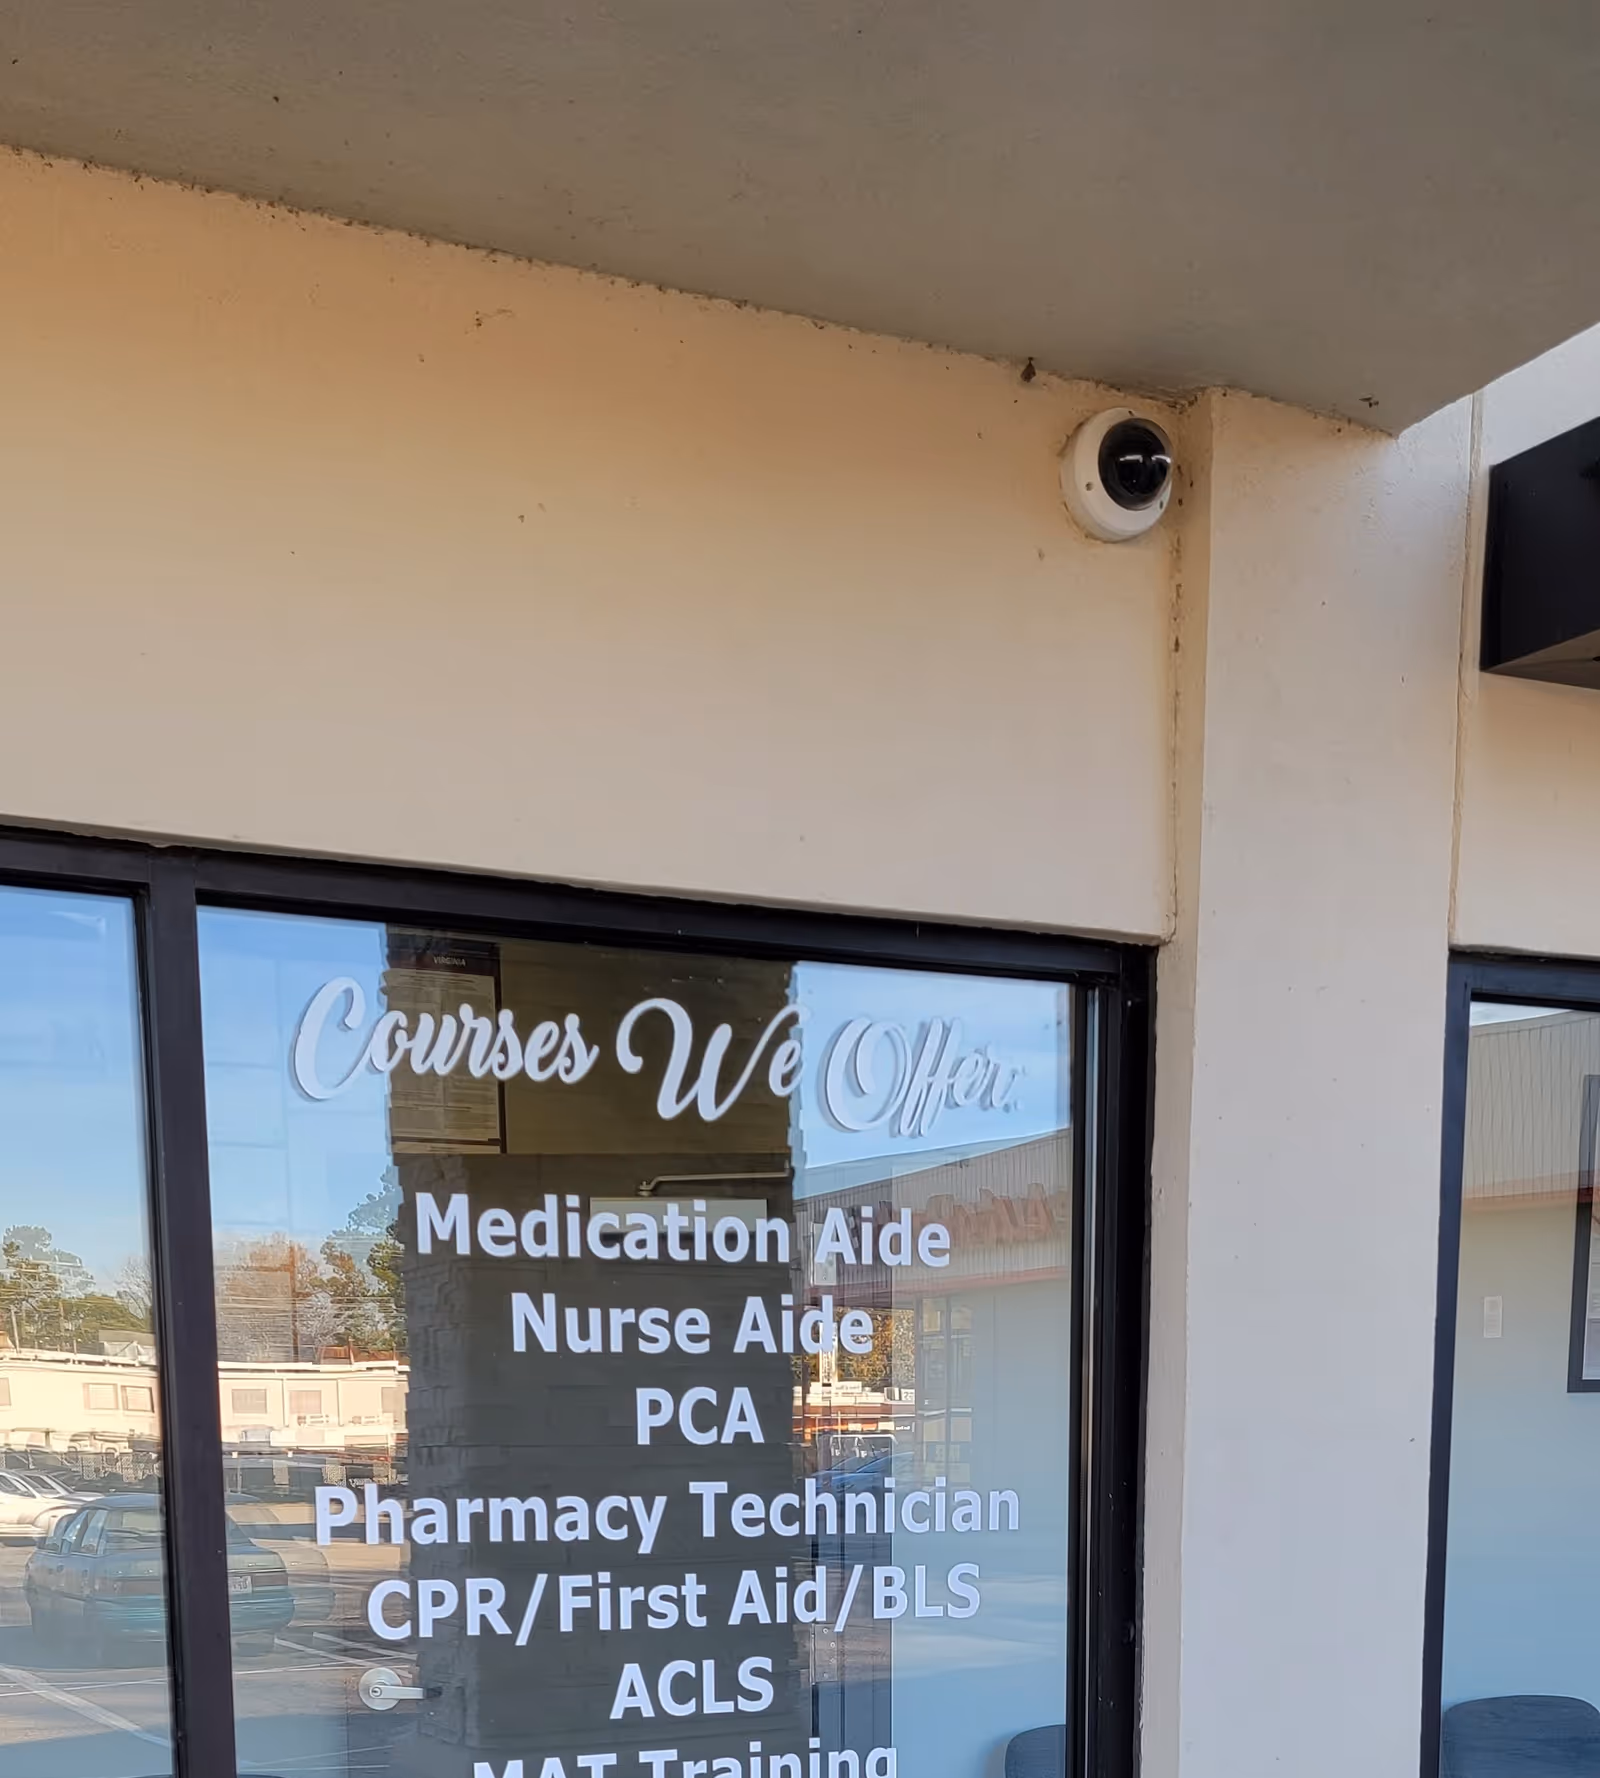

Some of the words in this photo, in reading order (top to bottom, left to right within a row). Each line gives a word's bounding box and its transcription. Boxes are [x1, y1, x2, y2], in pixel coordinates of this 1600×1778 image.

[294, 976, 599, 1101] Courses
[616, 998, 811, 1122] We
[415, 1192, 790, 1263] Medication
[814, 1205, 952, 1267] Aide
[511, 1292, 710, 1354] Nurse
[733, 1293, 874, 1355] Aide
[636, 1386, 765, 1445] PCA
[314, 1482, 667, 1554] Pharmacy
[689, 1477, 1020, 1537] Technician
[366, 1572, 707, 1646] CPR/First
[728, 1562, 982, 1633] Aid/BLS
[609, 1656, 775, 1720] ACLS
